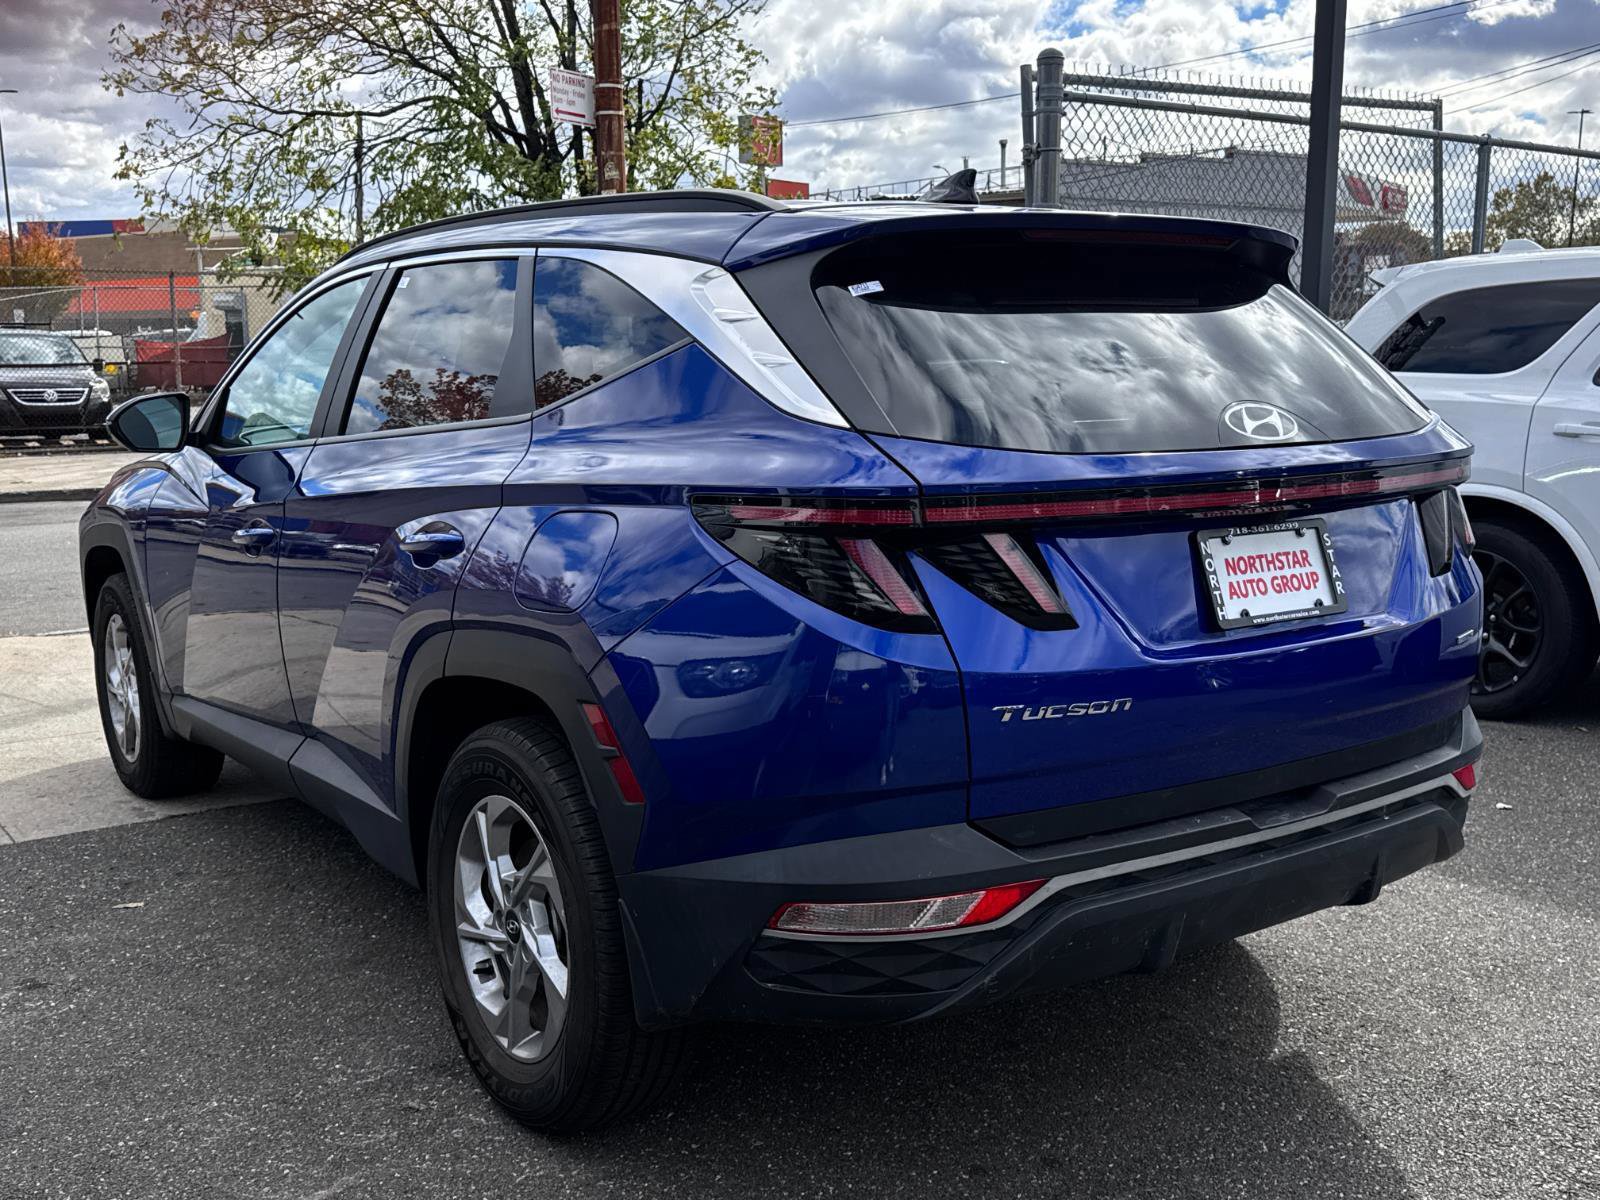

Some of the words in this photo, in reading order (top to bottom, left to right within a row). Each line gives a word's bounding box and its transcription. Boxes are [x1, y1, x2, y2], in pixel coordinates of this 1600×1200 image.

[552, 73, 560, 83] NO
[561, 75, 585, 88] PARKING
[1224, 549, 1313, 577] NORTHSTAR
[1323, 533, 1345, 594] STAR
[1200, 541, 1228, 621] NORTH
[1228, 577, 1268, 601] AUTO
[1270, 571, 1320, 594] GROUP
